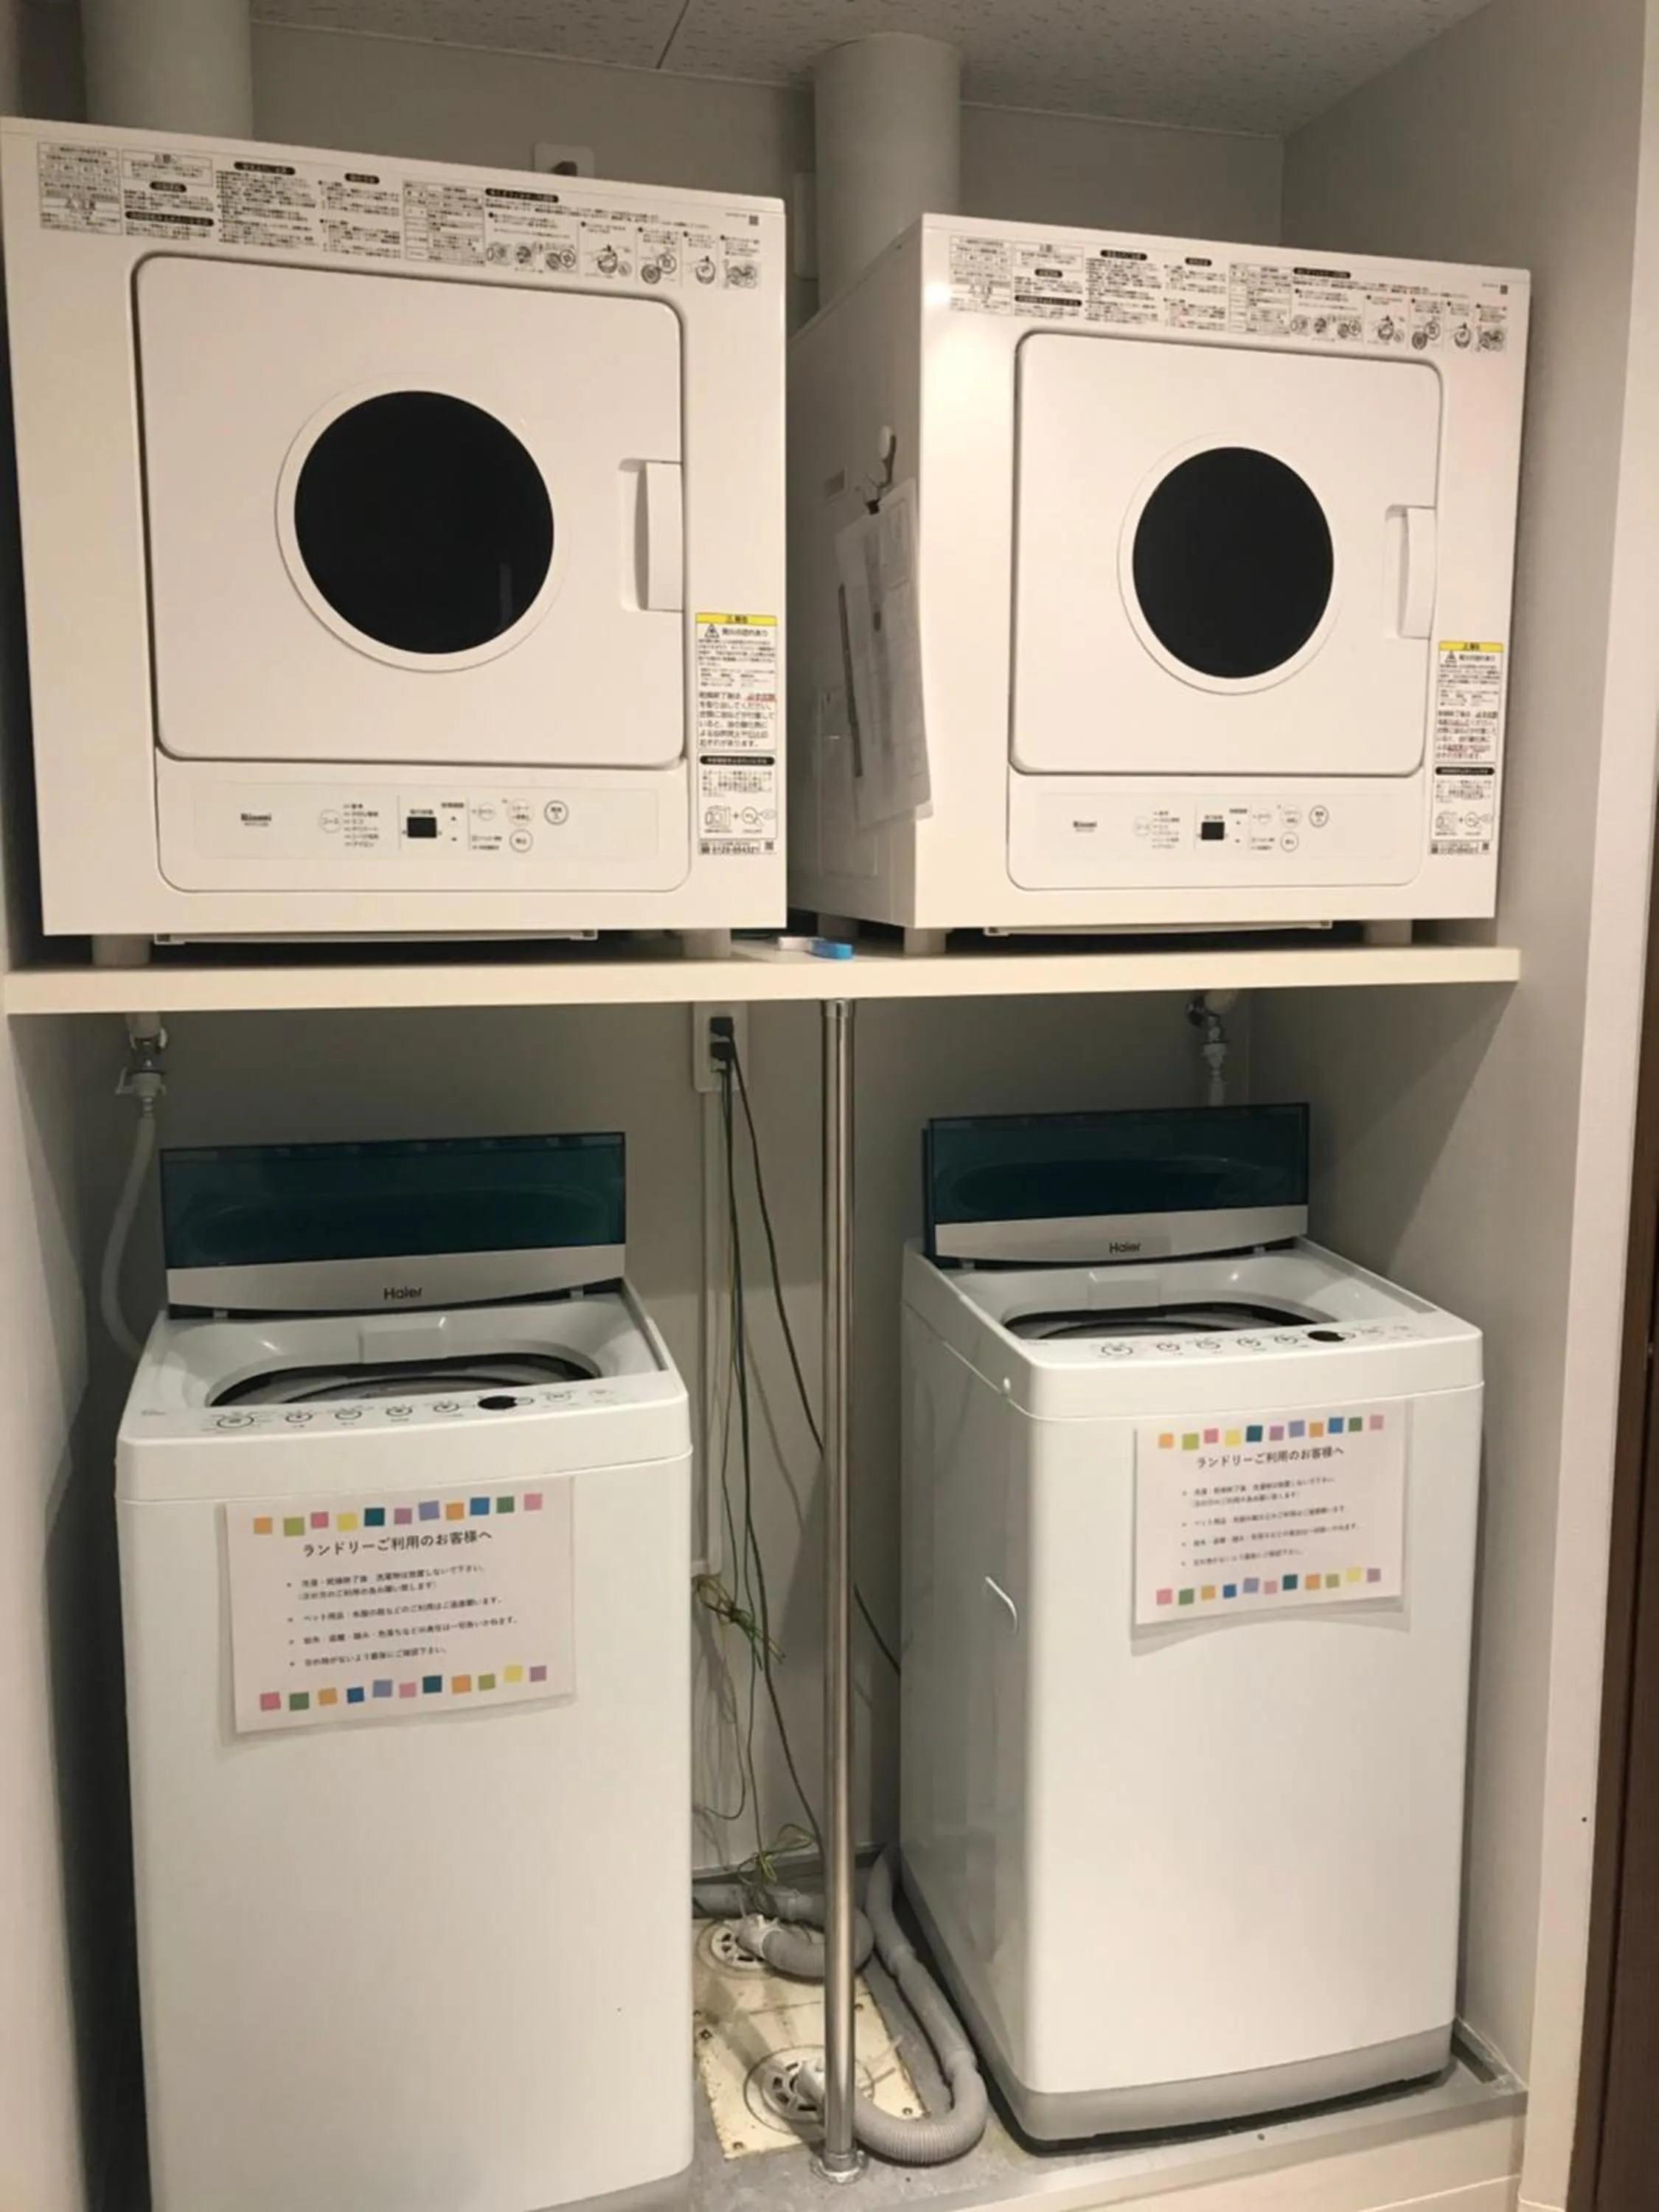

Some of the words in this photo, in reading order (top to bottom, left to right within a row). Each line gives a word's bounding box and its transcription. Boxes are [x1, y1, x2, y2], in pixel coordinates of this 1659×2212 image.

[1109, 1241, 1142, 1254] Haier
[383, 1285, 423, 1301] Haier
[1197, 1446, 1344, 1469] ランドリーご利用のお客様へ
[303, 1529, 493, 1557] ランドリーご利用のお客様へ
